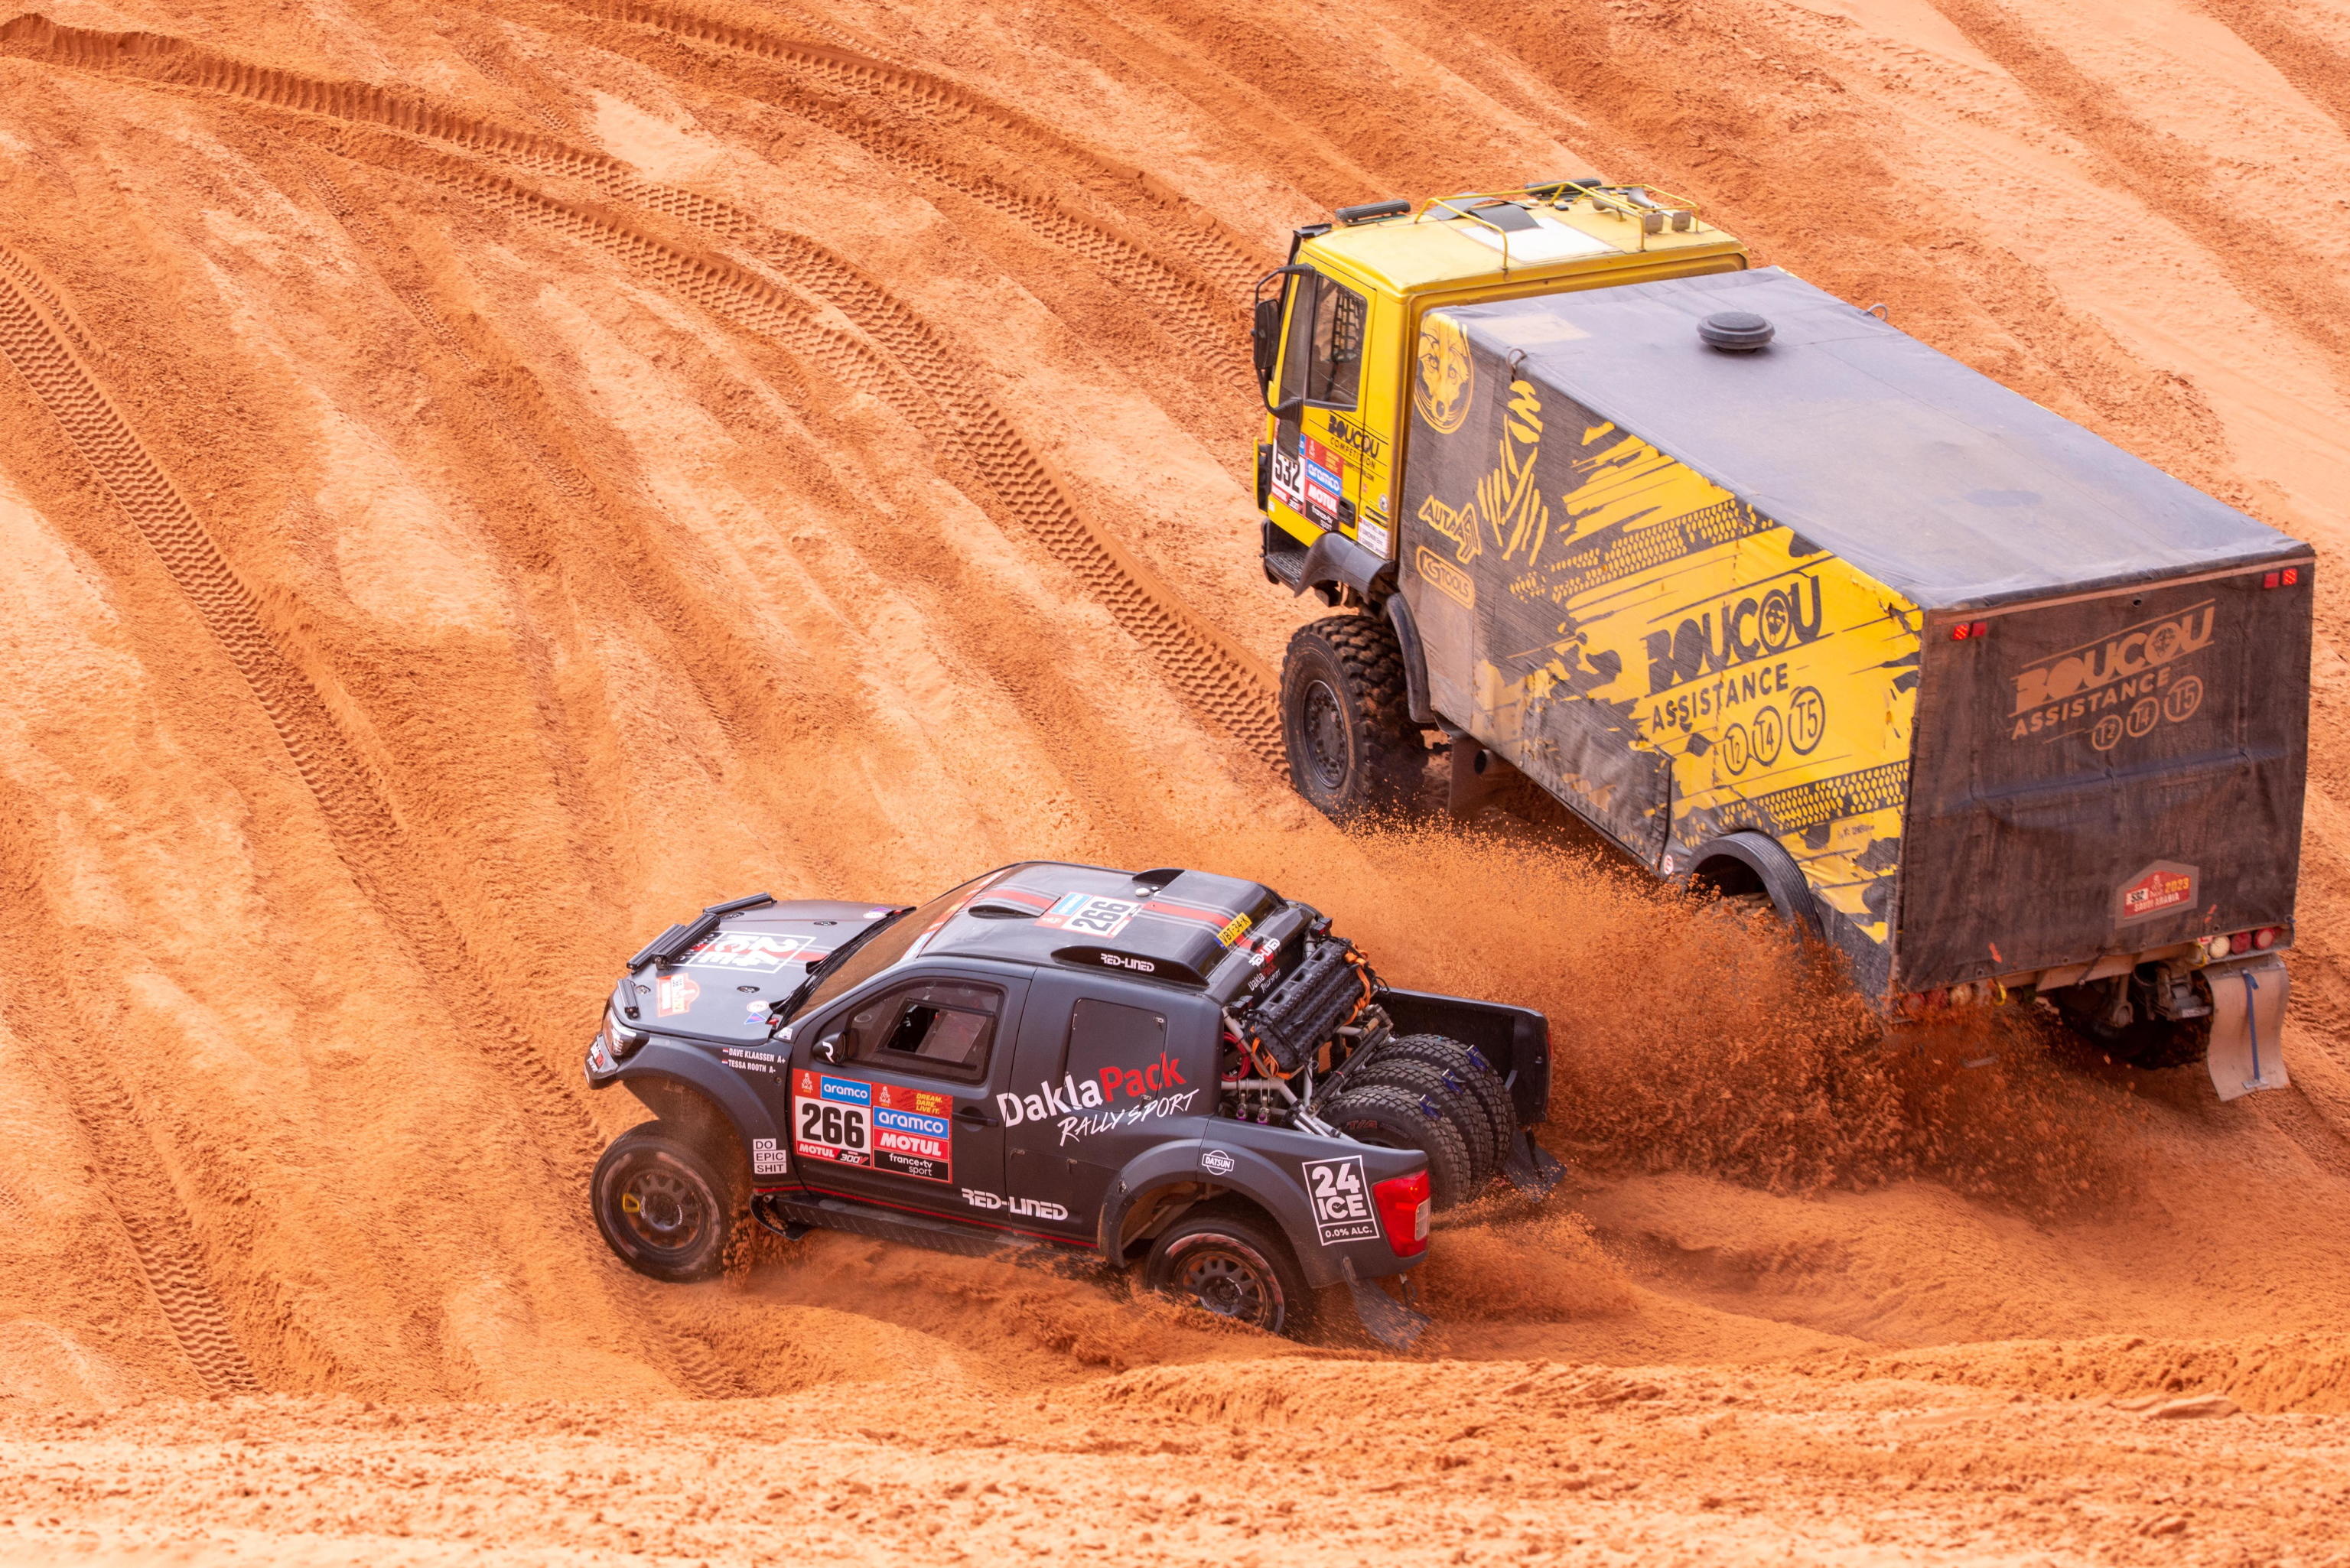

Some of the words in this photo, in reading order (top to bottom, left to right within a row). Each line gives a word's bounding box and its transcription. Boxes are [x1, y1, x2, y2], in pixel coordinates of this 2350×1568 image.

[1328, 414, 1380, 460] BOUCOU
[1330, 437, 1376, 469] COMPETITION
[1274, 451, 1300, 493] 532
[1307, 463, 1340, 492] aramco
[1307, 483, 1338, 513] MOTUL
[1641, 575, 1822, 695] BOUCOU
[2013, 606, 2215, 714] BOUCOU
[1652, 662, 1789, 734] ASSISTANCE
[2011, 666, 2171, 740] ASSISTANCE
[2173, 682, 2195, 713] T5
[1795, 698, 1818, 741] T5
[2165, 877, 2189, 894] 2023
[2154, 891, 2179, 906] ARABIA
[1071, 900, 1131, 932] 266
[1219, 915, 1250, 944] VBT-34-K
[1100, 952, 1155, 973] RED-LINED
[727, 1059, 747, 1069] TESSA
[747, 1062, 767, 1072] ROOTH
[769, 1065, 776, 1074] A-
[728, 1047, 744, 1058] DAVE
[744, 1049, 775, 1062] KLAASSEN
[776, 1055, 786, 1065] A+
[823, 1083, 868, 1099] aramco
[916, 1093, 943, 1103] DREAM.
[996, 1051, 1187, 1128] DaklaPack
[916, 1099, 937, 1108] DARE.
[916, 1105, 932, 1114] LIVE
[802, 1102, 865, 1149] 266
[878, 1111, 944, 1134] aramco
[755, 1140, 773, 1150] DO
[799, 1143, 835, 1158] MOTUL
[880, 1132, 942, 1156] MOTUL
[756, 1152, 784, 1161] EPIC
[757, 1163, 784, 1173] SHIT
[839, 1153, 869, 1164] 300V
[1205, 1156, 1232, 1169] DATSUN
[908, 1166, 933, 1176] sport
[1311, 1163, 1361, 1198] 24
[961, 1187, 1069, 1222] RED-LINED
[1317, 1193, 1367, 1221] ICE
[1325, 1228, 1349, 1238] 0.0%
[1350, 1226, 1373, 1236] ALC.
